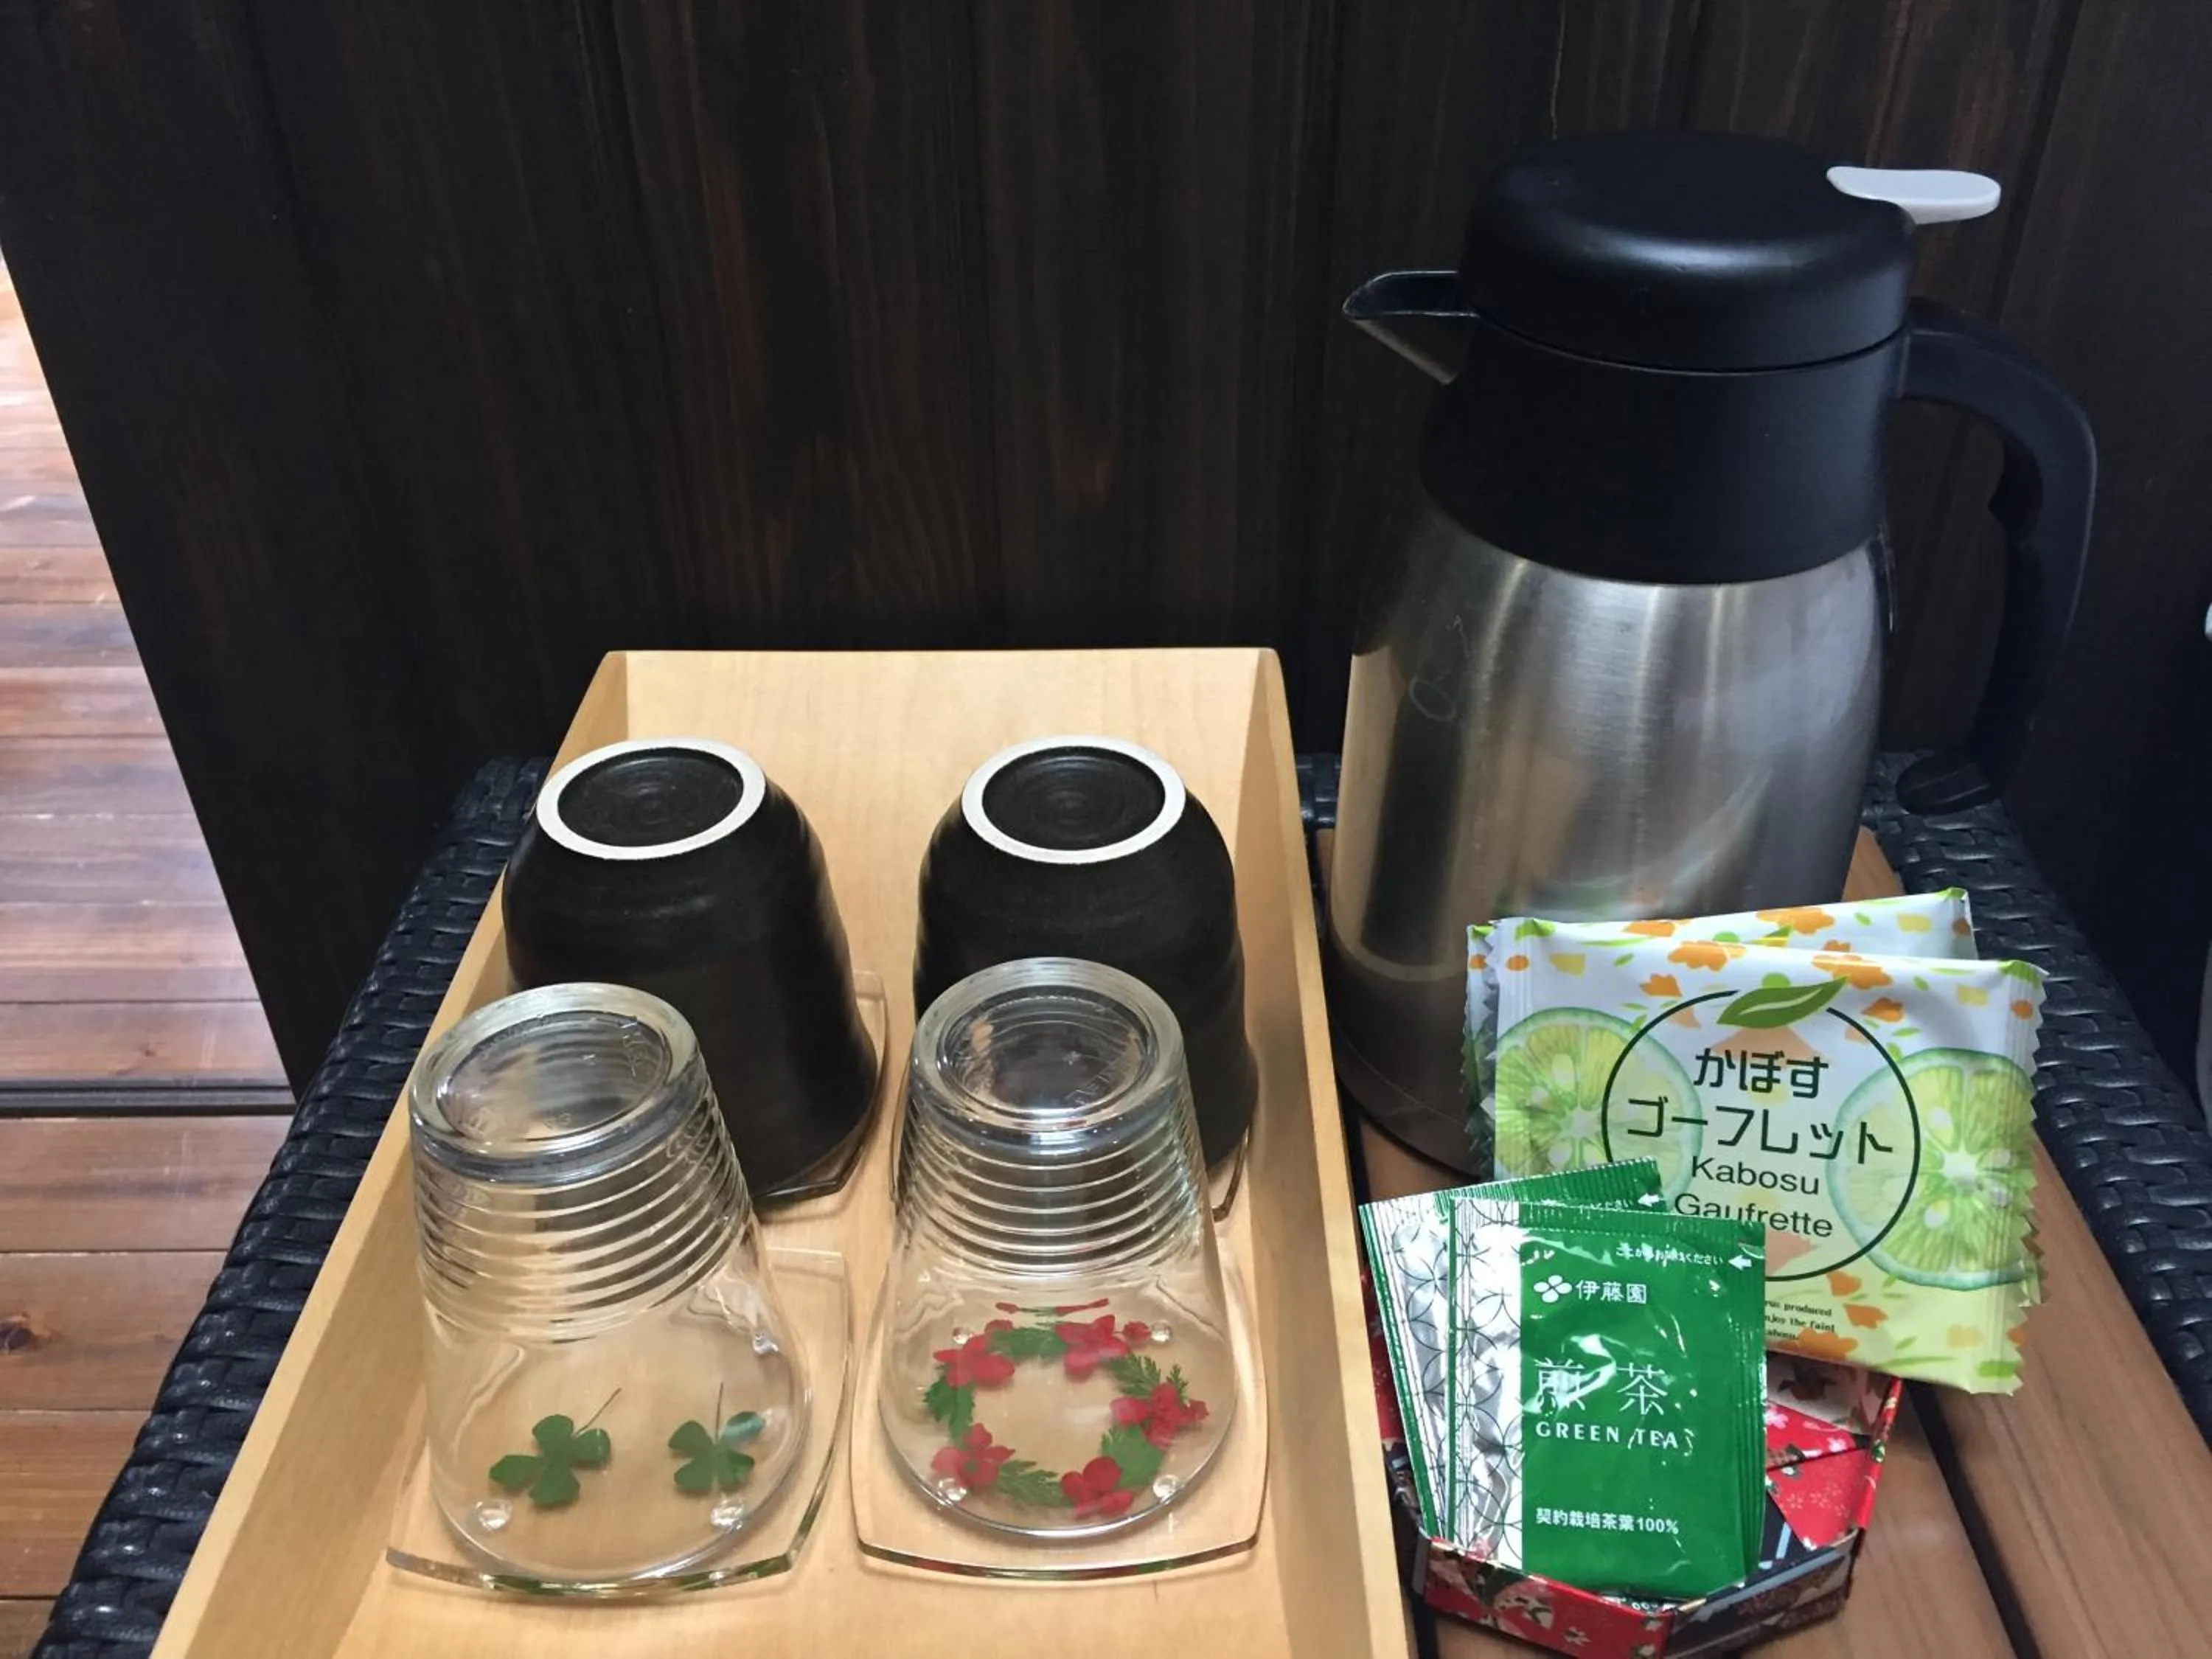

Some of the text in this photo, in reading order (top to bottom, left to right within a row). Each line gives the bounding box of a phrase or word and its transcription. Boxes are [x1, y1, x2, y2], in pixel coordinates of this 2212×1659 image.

[1694, 1047, 1829, 1099] かぼす
[1627, 1095, 1893, 1165] ゴーフレット
[1691, 1155, 1820, 1196] Kabosu
[1674, 1193, 1833, 1238] Gaufrette
[1575, 1279, 1647, 1304] 伊藤園
[1764, 1315, 1786, 1324] njoy
[1790, 1318, 1806, 1326] the
[1784, 1303, 1832, 1316] produced
[1535, 1421, 1679, 1450] GREEN TEA
[1536, 1507, 1680, 1535] 契約栽培茶葉100%
